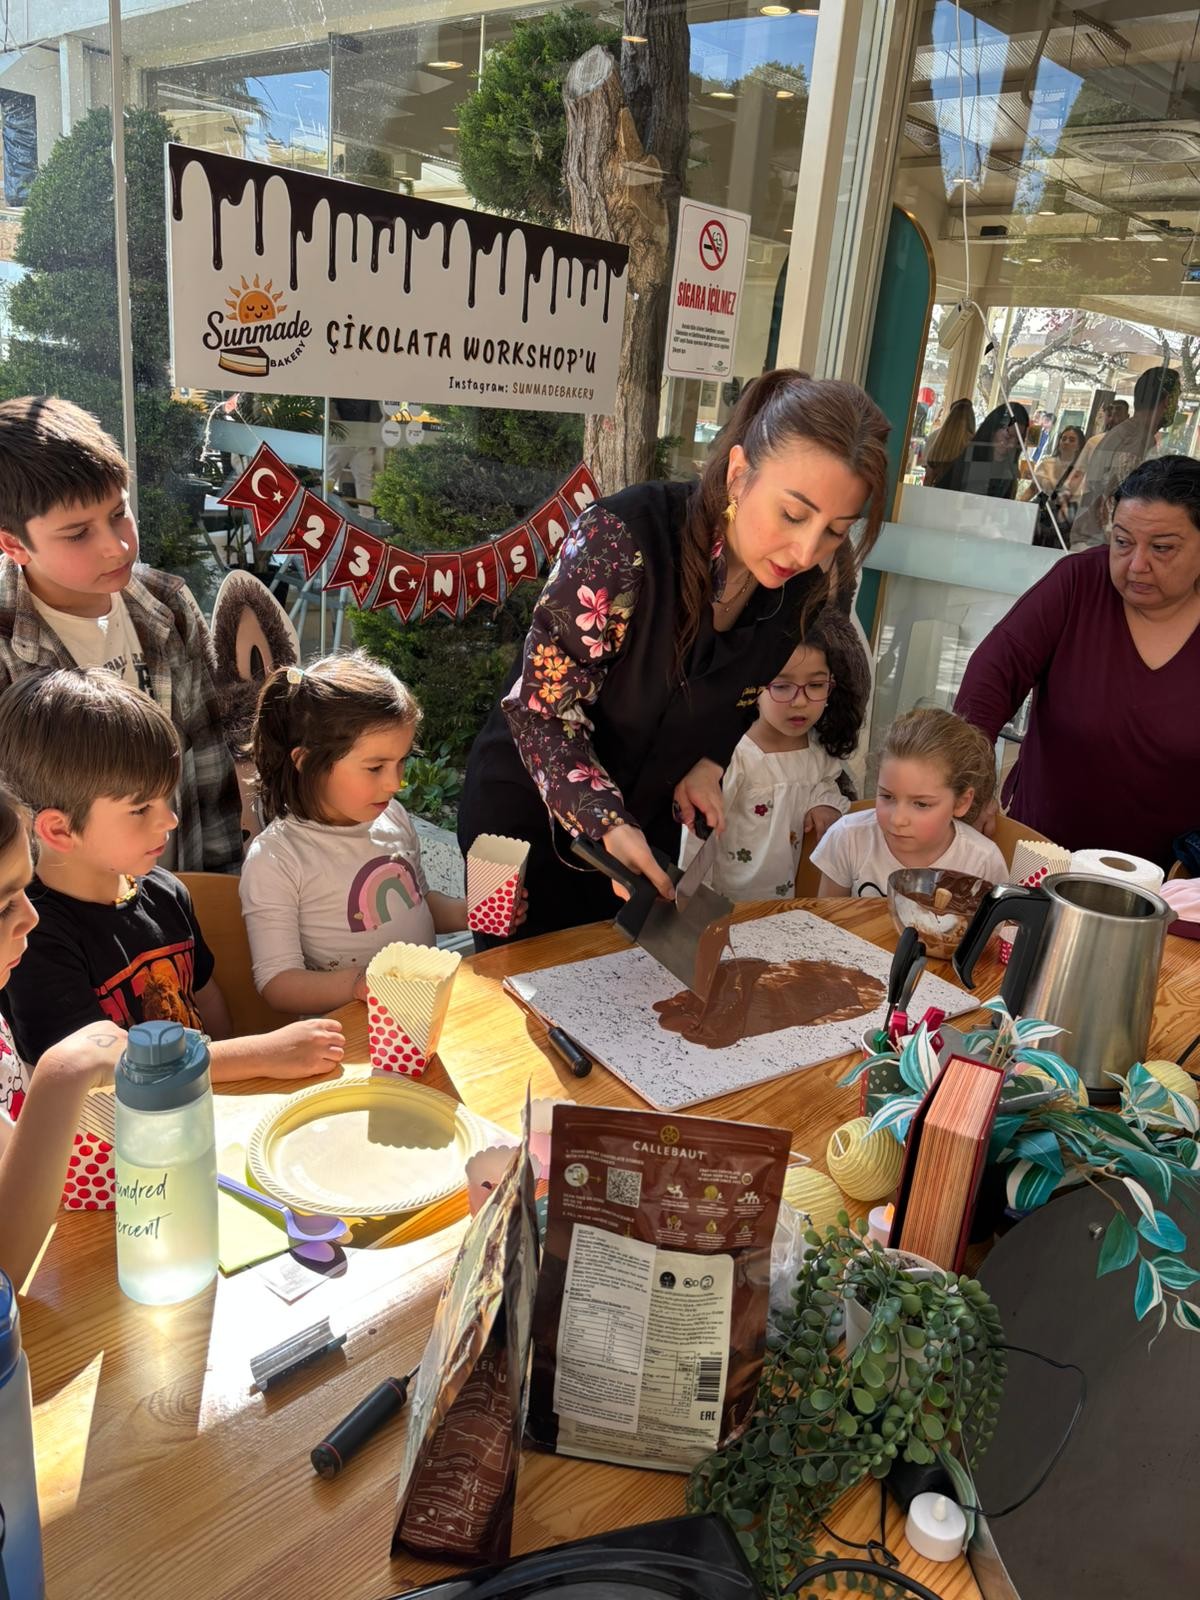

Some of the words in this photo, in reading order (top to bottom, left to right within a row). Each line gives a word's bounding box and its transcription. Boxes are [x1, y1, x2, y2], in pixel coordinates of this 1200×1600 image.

[677, 278, 706, 311] SİGARA
[707, 283, 737, 316] İÇİLMEZ
[203, 310, 313, 350] Sunmade
[326, 314, 451, 359] ÇİKOLATA
[463, 336, 597, 374] WORKSHOP'U
[270, 340, 306, 368] BAKERY
[448, 376, 509, 394] Instagram:
[512, 382, 595, 400] SUNMADEBAKERY
[632, 1140, 707, 1161] CALLEBAUT
[115, 1173, 168, 1206] undred
[115, 1212, 173, 1240] ercent
